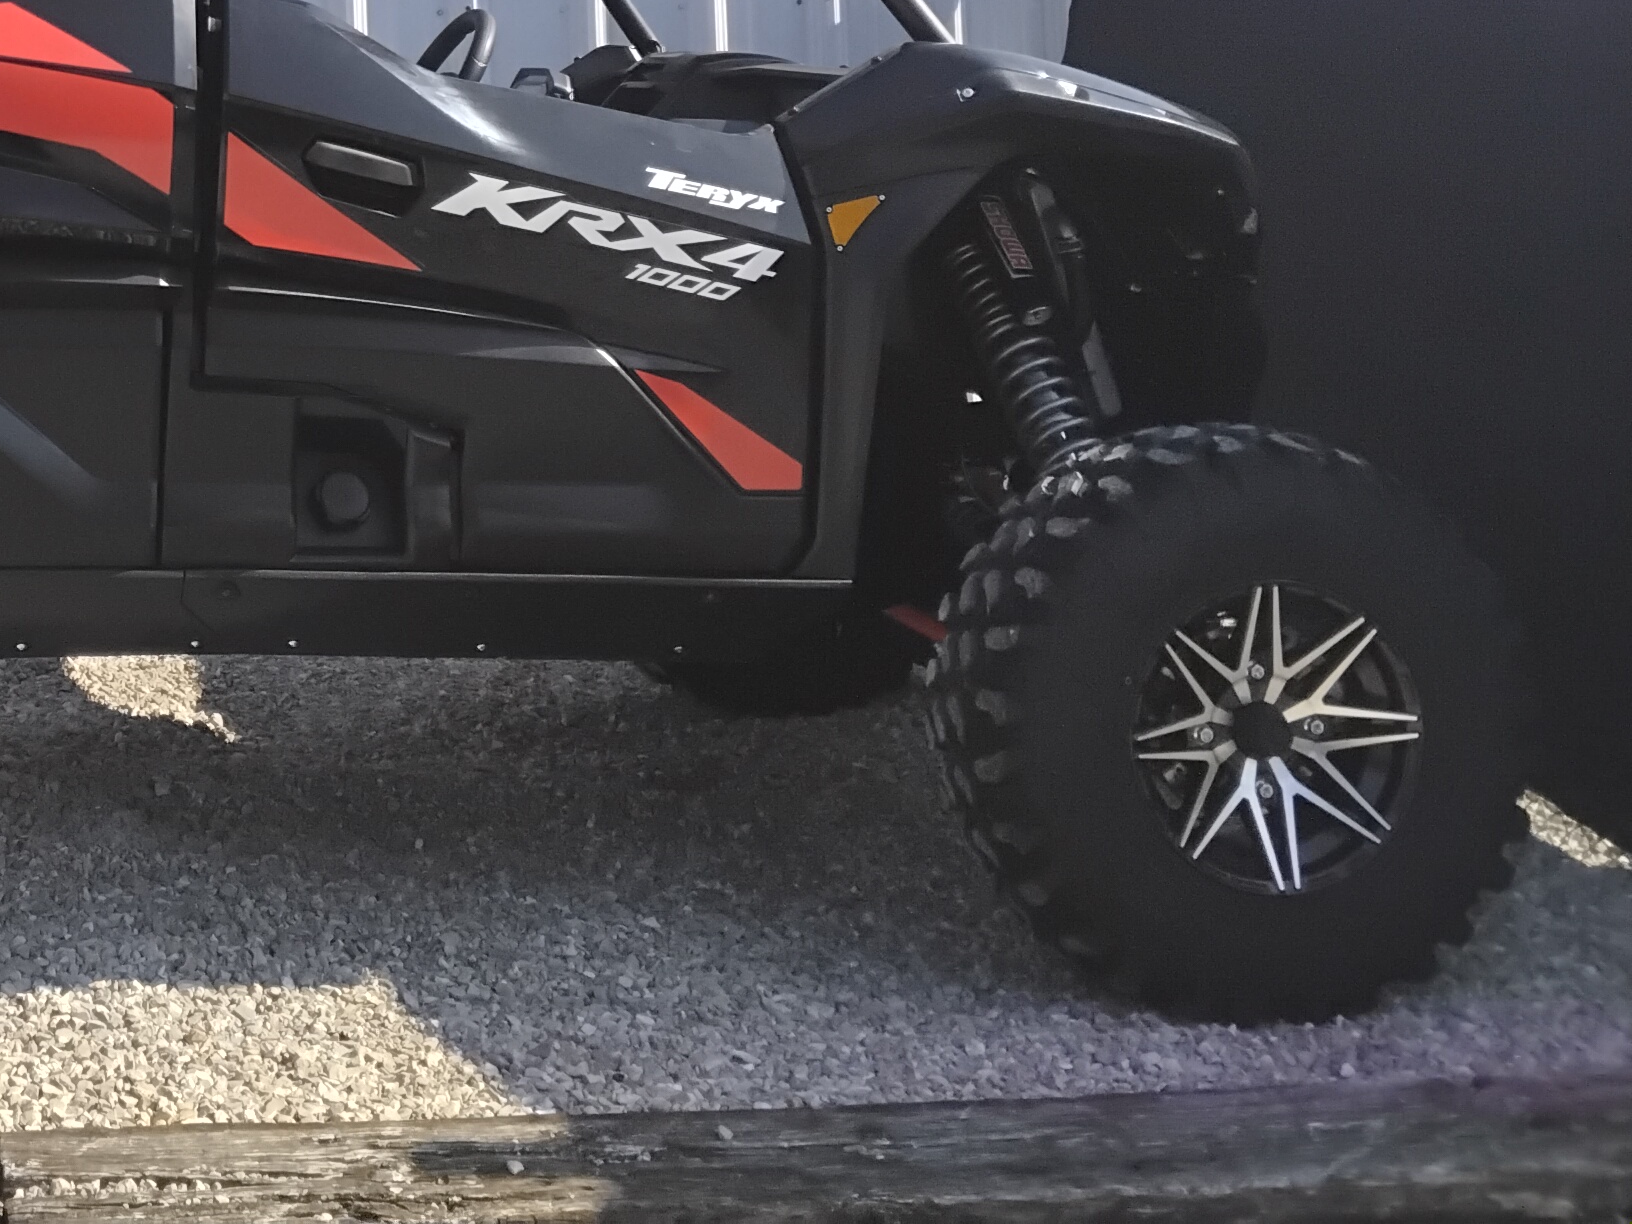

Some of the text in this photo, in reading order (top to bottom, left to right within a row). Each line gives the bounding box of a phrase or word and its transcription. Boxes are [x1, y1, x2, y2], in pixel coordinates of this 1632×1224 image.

[431, 171, 784, 283] KRX4
[980, 201, 1033, 270] SHOWA
[625, 263, 742, 301] 1000
